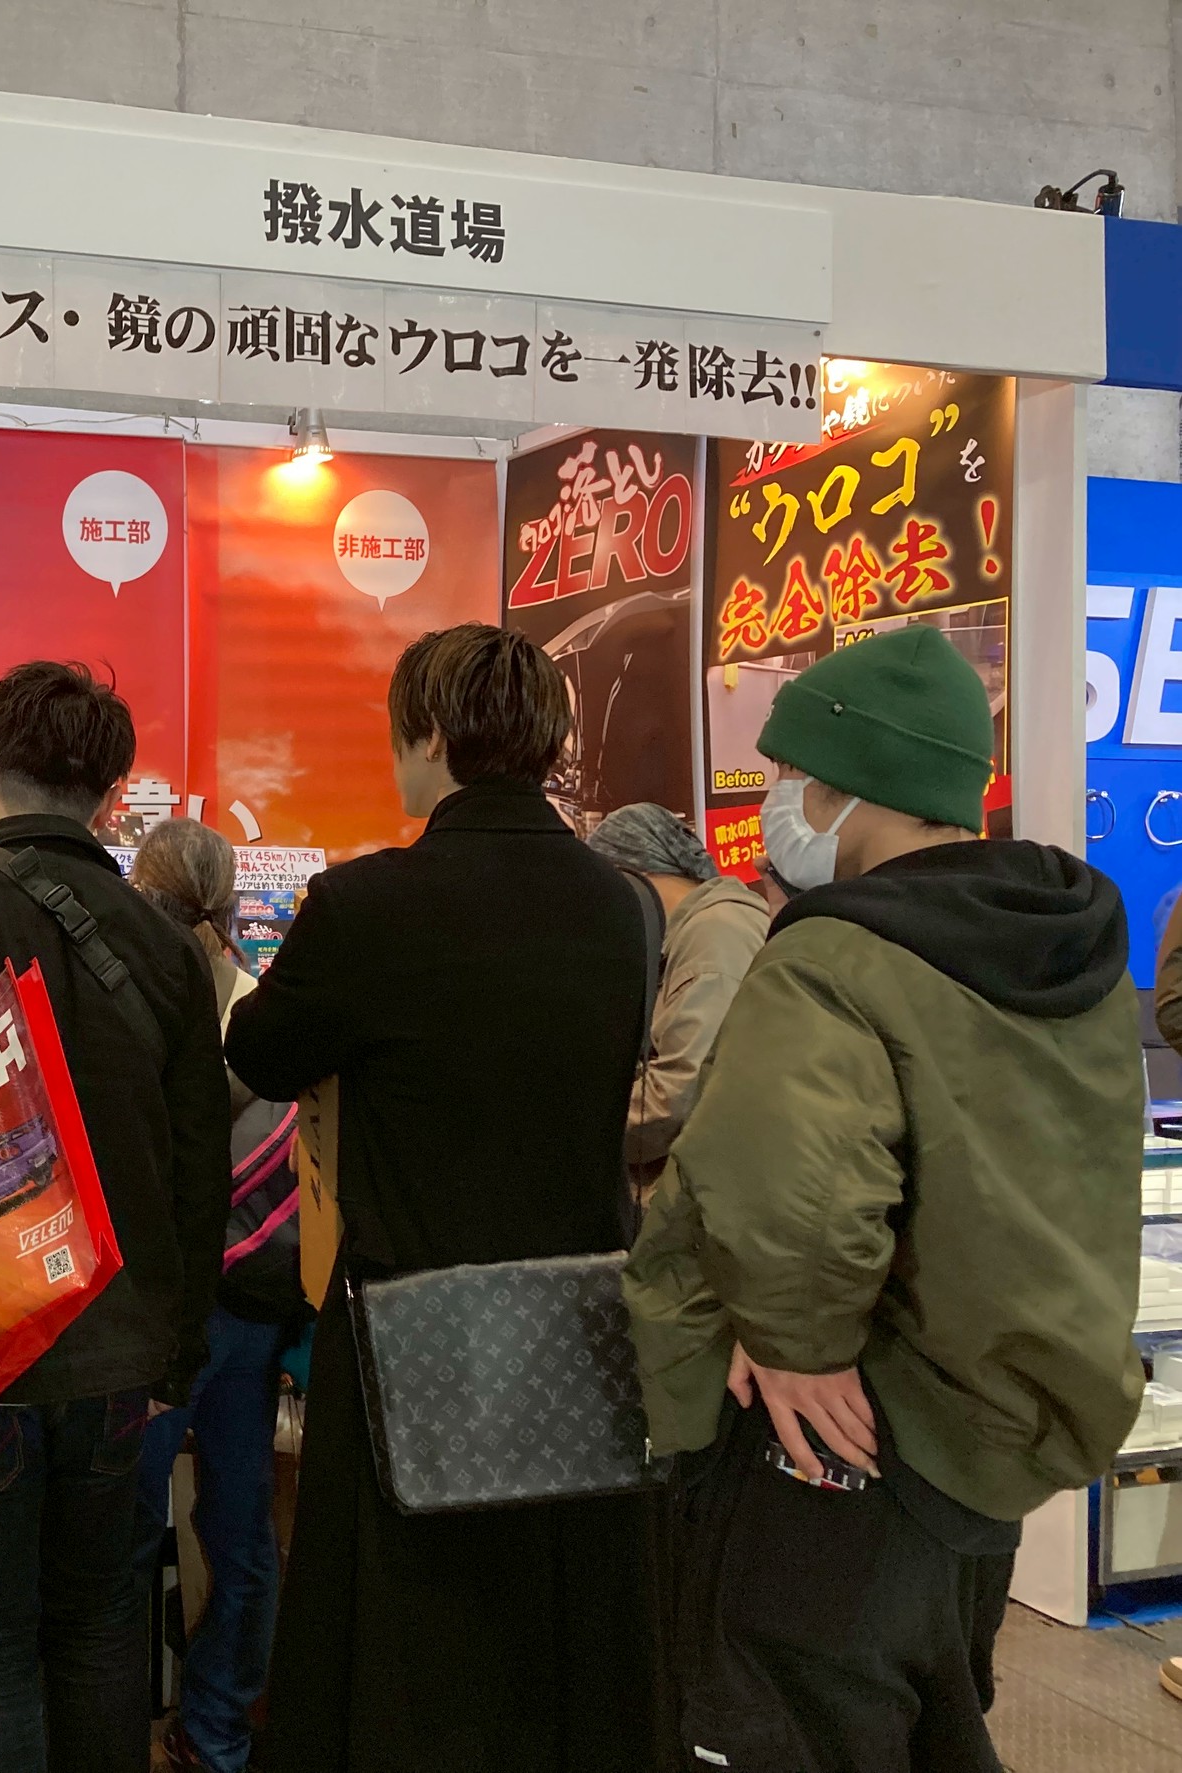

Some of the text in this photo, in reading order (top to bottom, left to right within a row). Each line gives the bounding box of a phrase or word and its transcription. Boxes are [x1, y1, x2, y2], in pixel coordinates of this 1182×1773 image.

[263, 178, 505, 263] 撥水道場
[79, 516, 151, 545] 施工部
[508, 473, 693, 610] ZERO
[337, 533, 426, 562] 非施工部
[715, 770, 764, 788] Before
